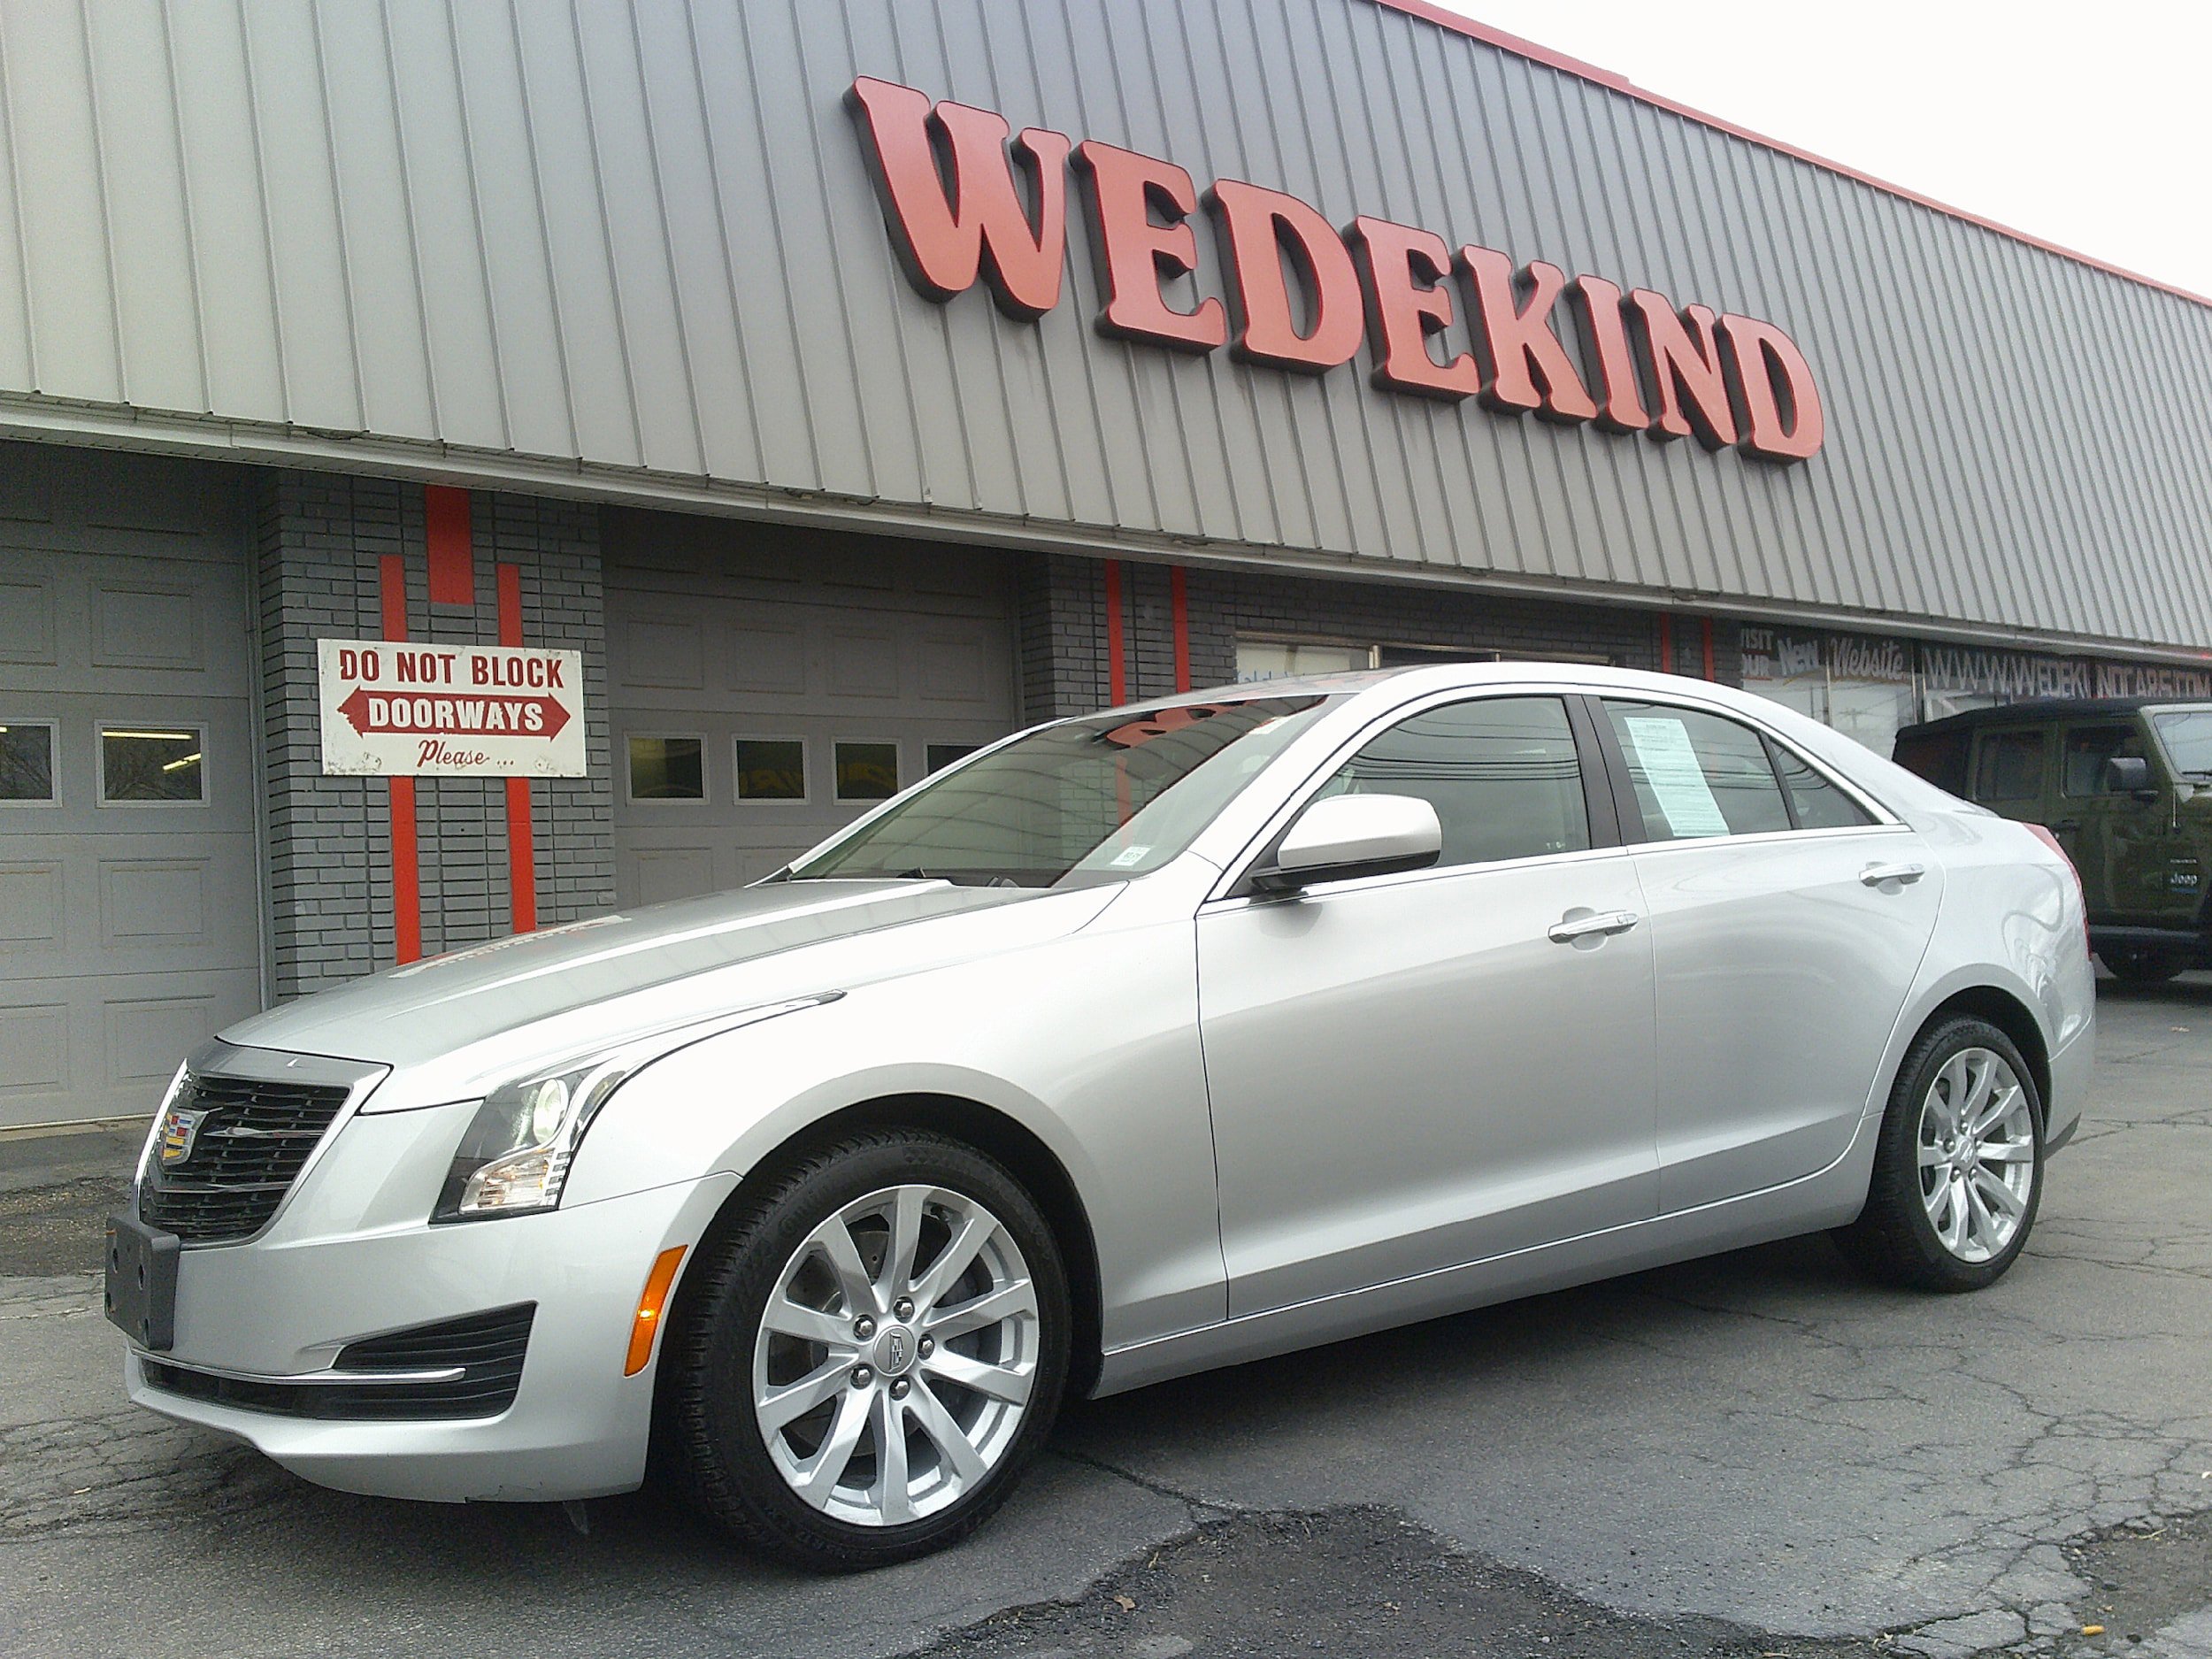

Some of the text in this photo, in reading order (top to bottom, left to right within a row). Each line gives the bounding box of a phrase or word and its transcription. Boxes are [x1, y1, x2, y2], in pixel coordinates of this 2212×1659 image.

[844, 76, 1823, 462] WEDEKIND
[339, 649, 564, 688] DO NOT BLOCK
[368, 697, 543, 731] DOORWAYS
[417, 740, 490, 768] Please
